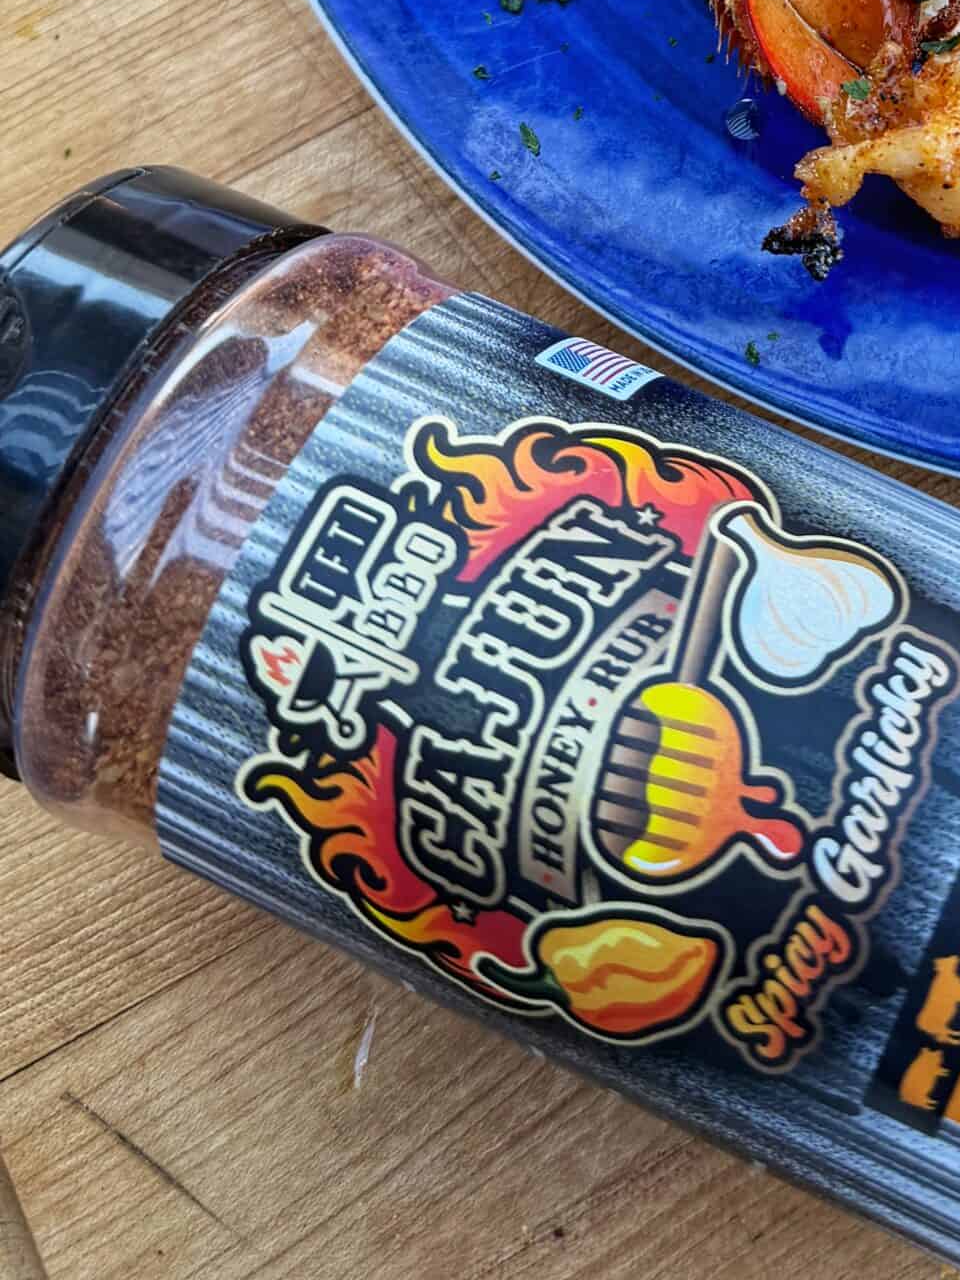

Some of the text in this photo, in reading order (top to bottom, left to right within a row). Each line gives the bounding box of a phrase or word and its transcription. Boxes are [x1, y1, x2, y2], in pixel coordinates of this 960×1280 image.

[608, 373, 638, 392] MADE
[300, 504, 378, 597] TFTI
[359, 525, 453, 646] BBQ
[403, 500, 675, 904] CAJUN
[530, 613, 674, 872] HONEY RUB
[726, 640, 950, 1059] Spicy Garlicky
